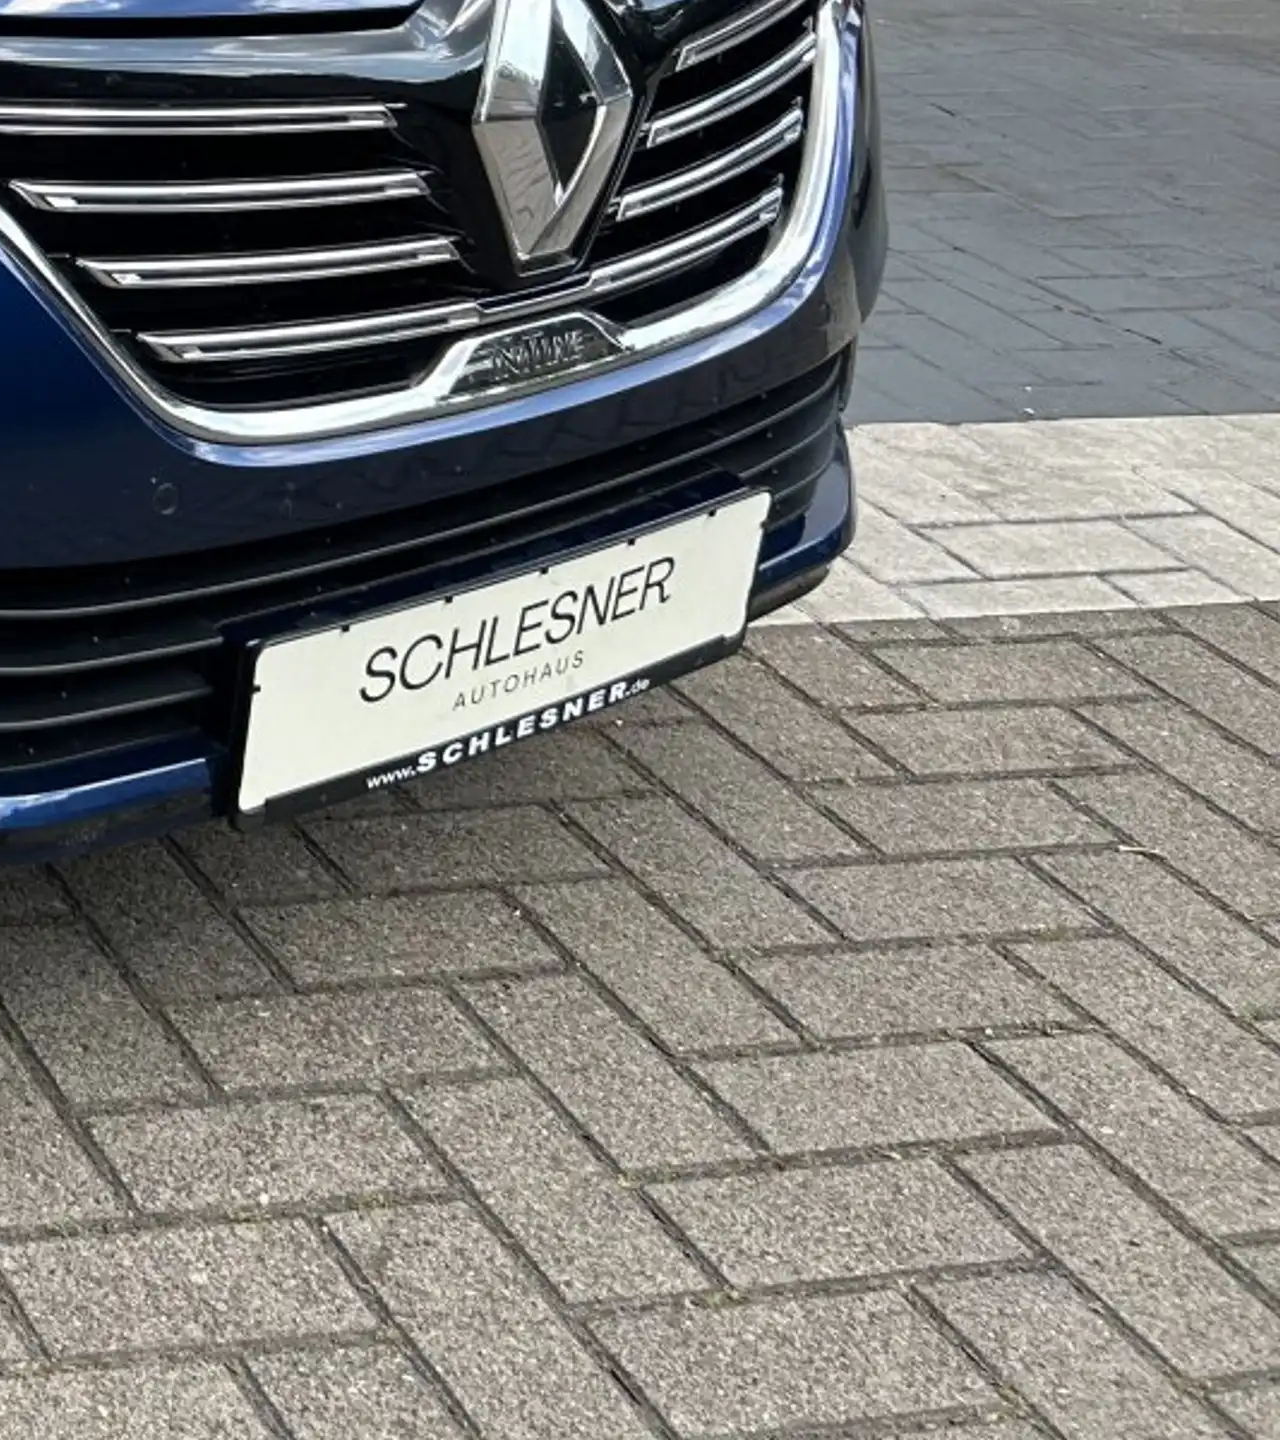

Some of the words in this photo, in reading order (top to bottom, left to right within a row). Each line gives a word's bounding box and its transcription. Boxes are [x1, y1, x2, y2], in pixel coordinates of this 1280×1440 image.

[359, 556, 677, 704] SCHLESNER
[452, 650, 586, 712] AUTOHAUS
[365, 677, 651, 790] www.SCHLESNER.de
